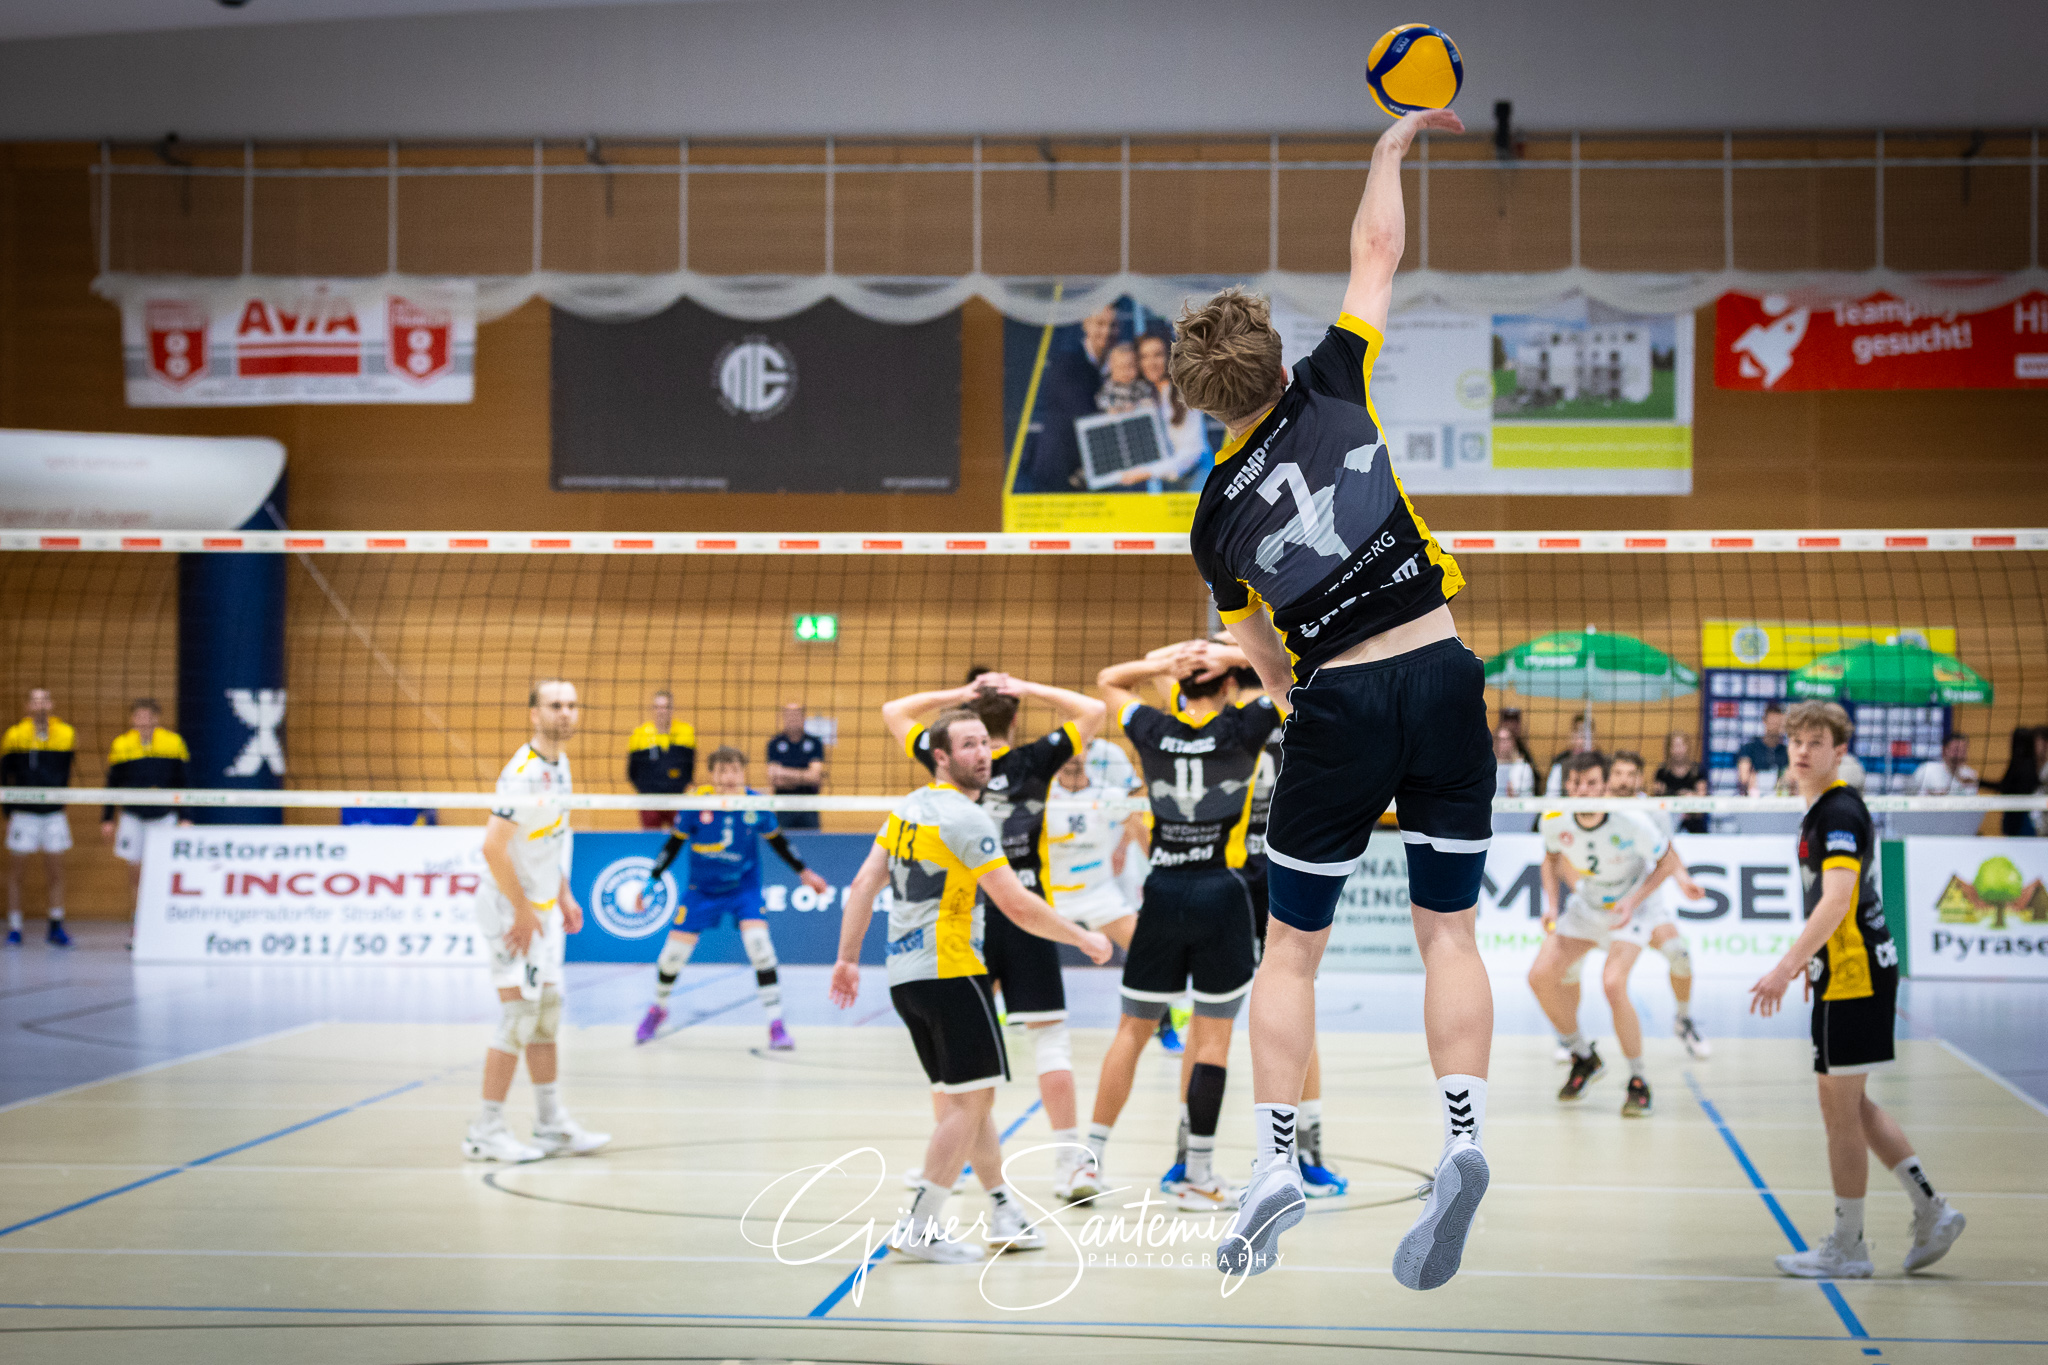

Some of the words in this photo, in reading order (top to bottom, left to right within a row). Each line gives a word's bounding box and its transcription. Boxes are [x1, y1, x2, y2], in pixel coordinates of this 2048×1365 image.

[1852, 320, 1973, 365] gesucht!
[1256, 461, 1320, 538] 7
[1174, 757, 1205, 798] 11
[172, 839, 347, 861] Ristorante
[896, 820, 919, 867] 13
[170, 865, 482, 897] L'INCONTR
[791, 885, 837, 912] OF
[206, 932, 250, 955] fon
[261, 934, 387, 958] 0911/50
[399, 935, 432, 956] 57
[444, 935, 476, 956] 71
[1701, 932, 1798, 954] HOLZ
[1932, 931, 2048, 962] Pyrase
